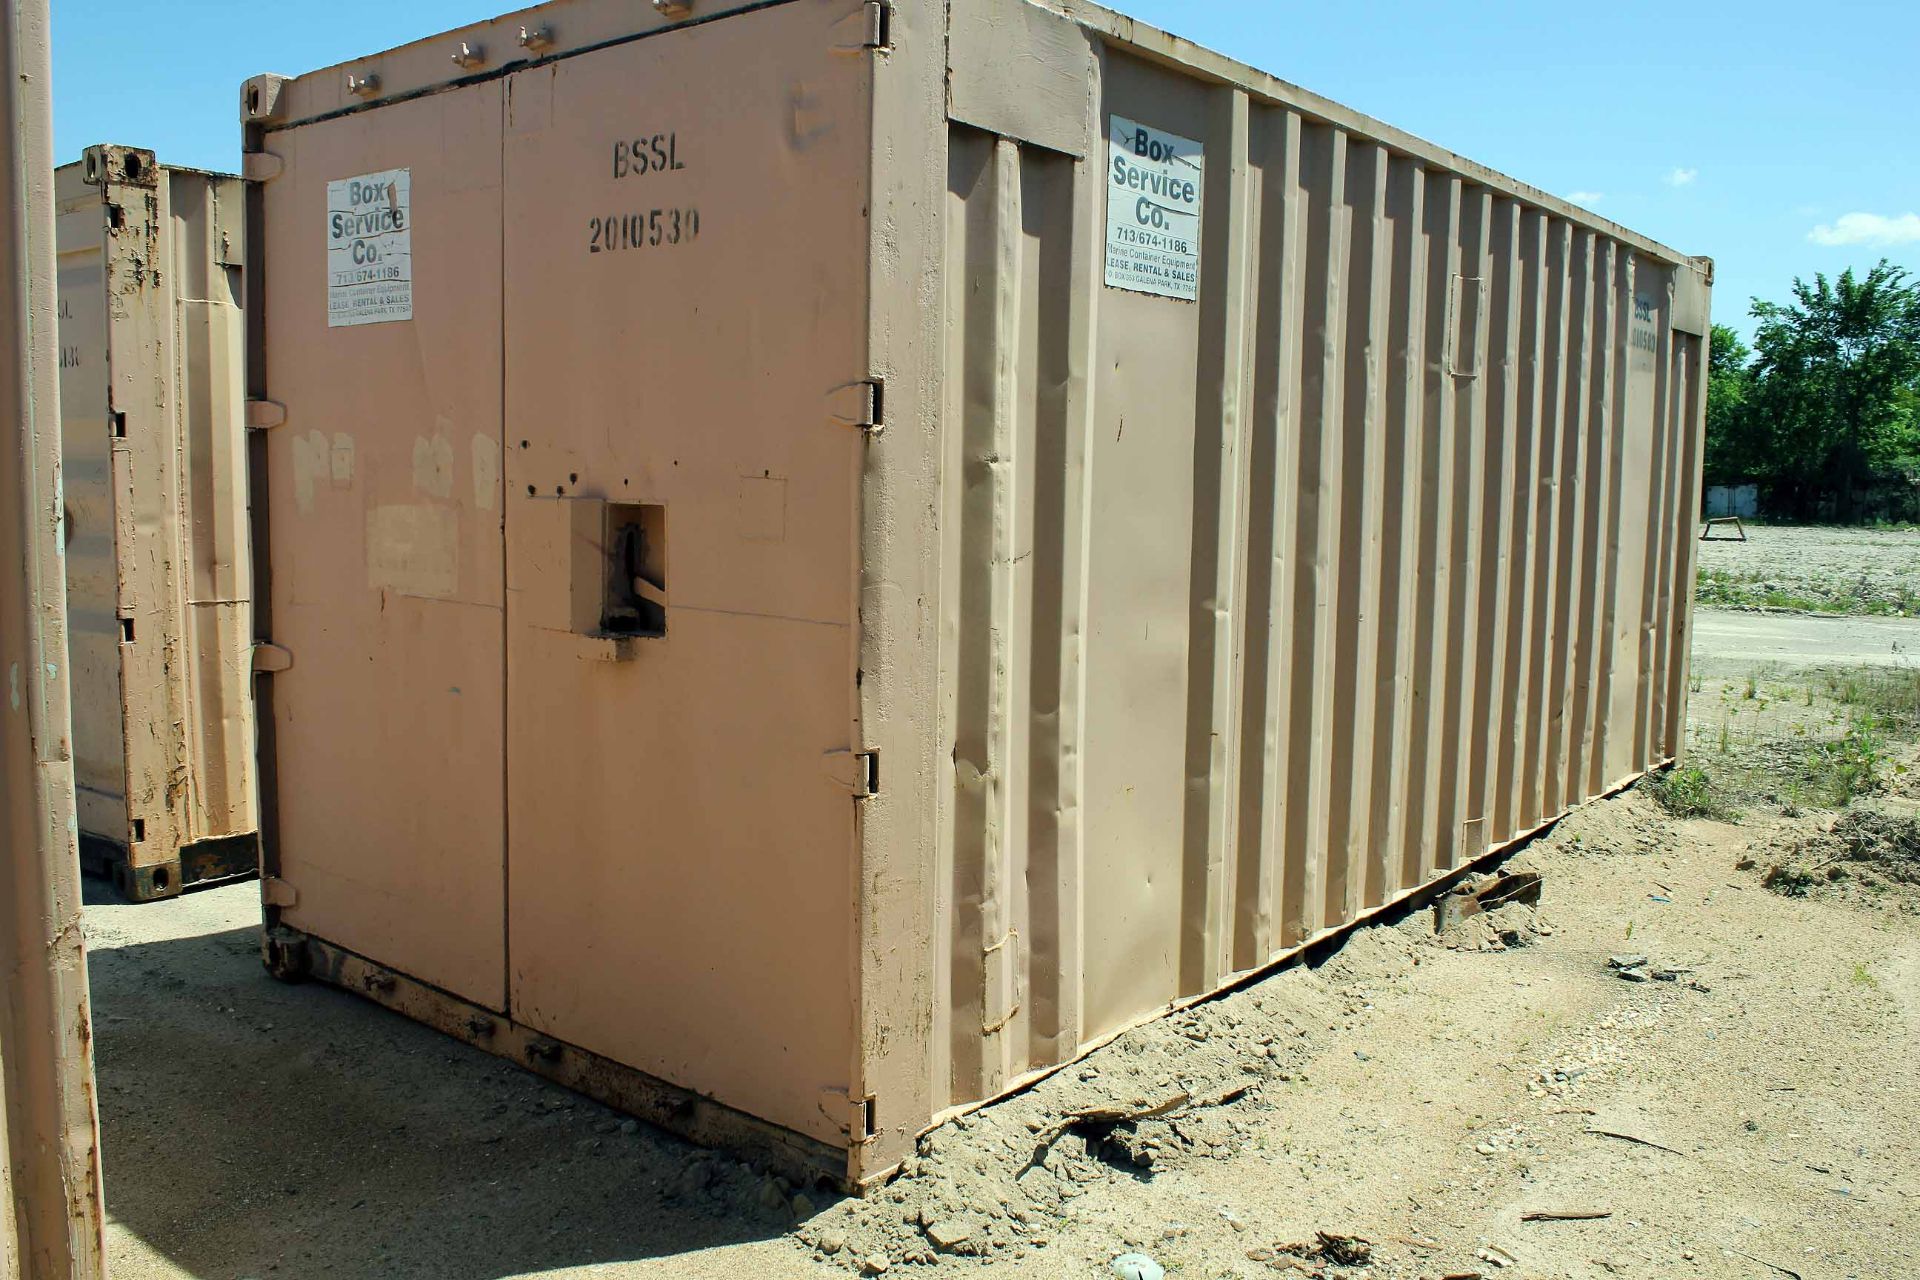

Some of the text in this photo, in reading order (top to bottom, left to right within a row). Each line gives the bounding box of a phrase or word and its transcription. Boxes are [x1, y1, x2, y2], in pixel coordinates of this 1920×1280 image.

[614, 131, 686, 179] BSSL
[1134, 128, 1175, 166] Box
[350, 181, 385, 206] Box
[1113, 155, 1195, 204] Service
[332, 207, 404, 239] Service
[1136, 196, 1170, 231] Co.
[590, 208, 700, 253] 2010530
[1117, 227, 1188, 254] 713/674-1186
[352, 239, 383, 265] Co.
[1130, 249, 1161, 264] Container
[1133, 262, 1162, 276] RENTAL
[1164, 268, 1169, 277] &
[1172, 270, 1195, 282] SALES
[353, 298, 378, 308] RENTAL
[386, 295, 410, 304] SALES
